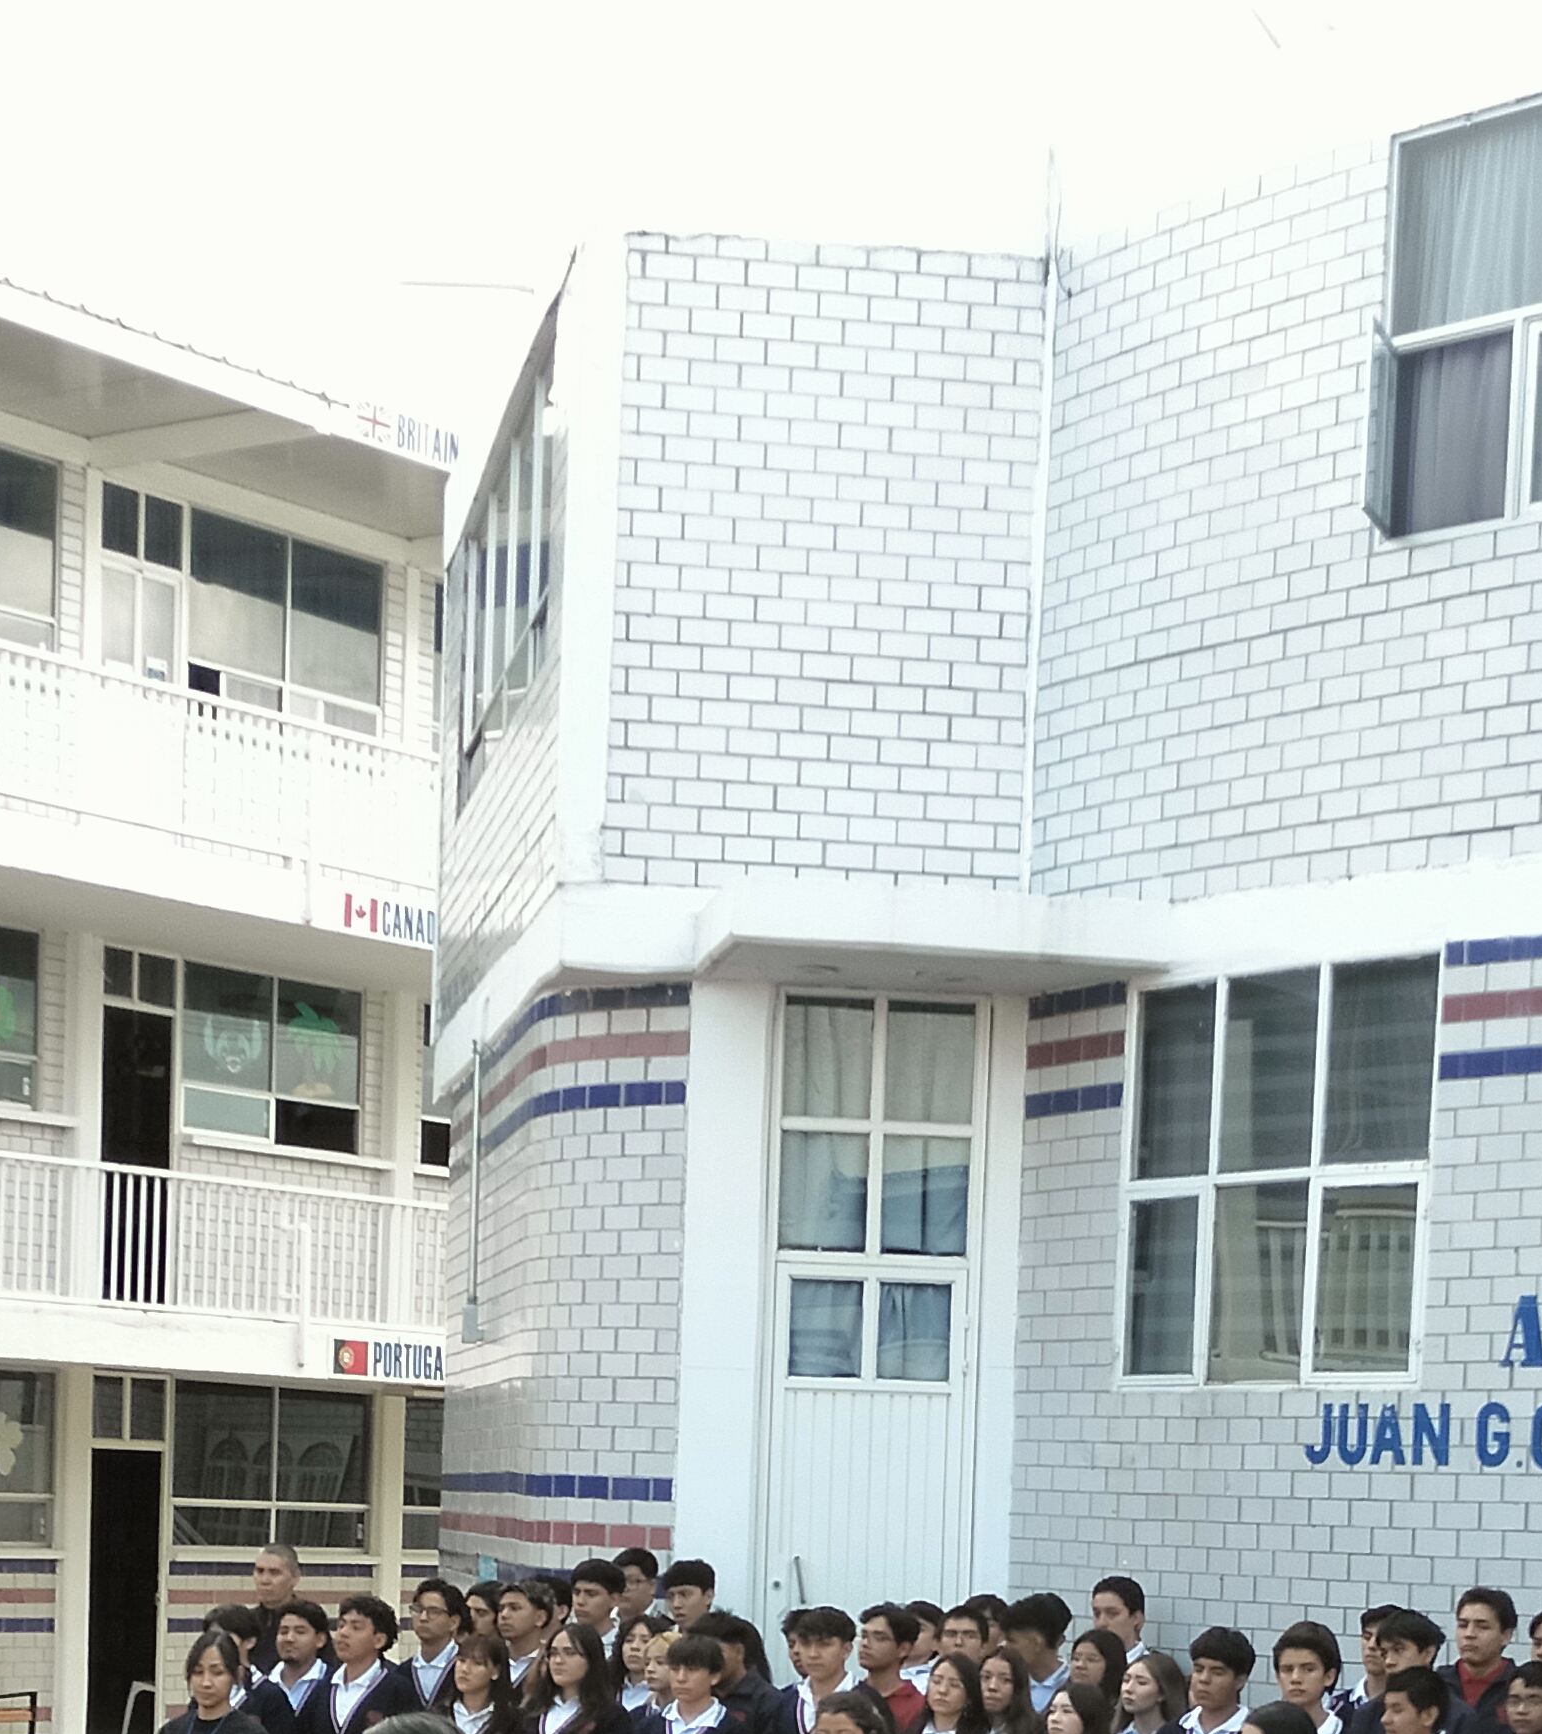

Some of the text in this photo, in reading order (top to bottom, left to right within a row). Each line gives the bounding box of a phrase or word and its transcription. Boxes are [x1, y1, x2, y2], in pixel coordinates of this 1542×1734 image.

[397, 414, 459, 464] BRITAIN
[373, 1341, 444, 1380] PORTUGA
[1304, 1402, 1451, 1466] JUAN
